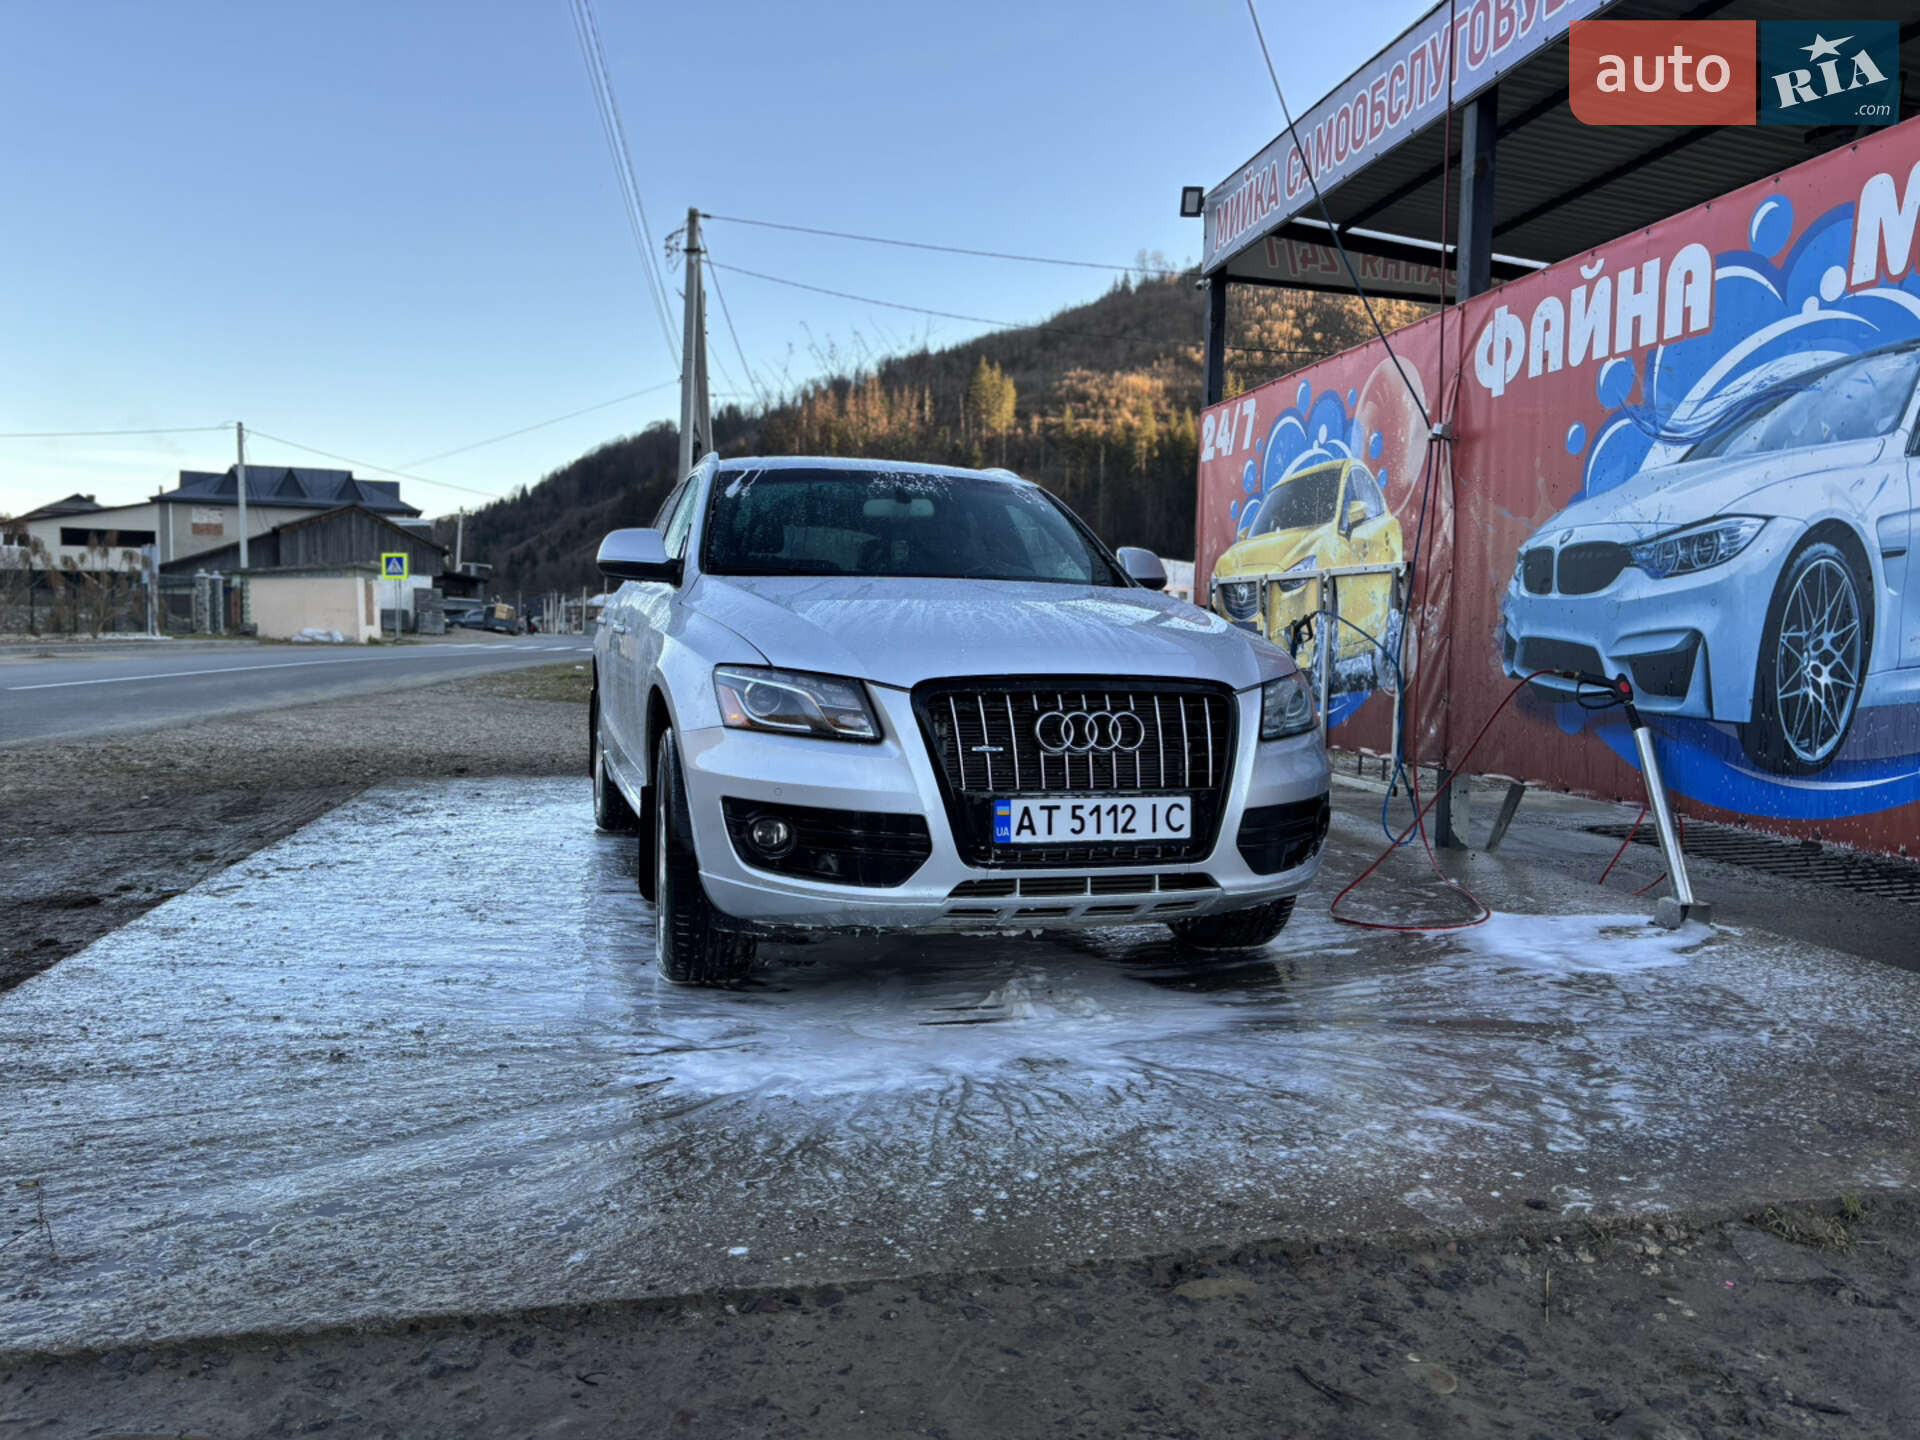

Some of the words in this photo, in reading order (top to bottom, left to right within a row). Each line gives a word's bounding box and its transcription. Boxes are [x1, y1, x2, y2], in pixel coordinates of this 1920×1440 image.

[1214, 160, 1281, 253] МИЙКА
[1285, 0, 1572, 200] САМООБСЛУГОВ
[1475, 243, 1712, 398] ФАЙНА
[1201, 398, 1256, 462] 24/7
[996, 826, 1010, 838] UA
[1015, 805, 1061, 836] AT
[1070, 803, 1137, 835] 5112
[1151, 803, 1186, 833] IC
